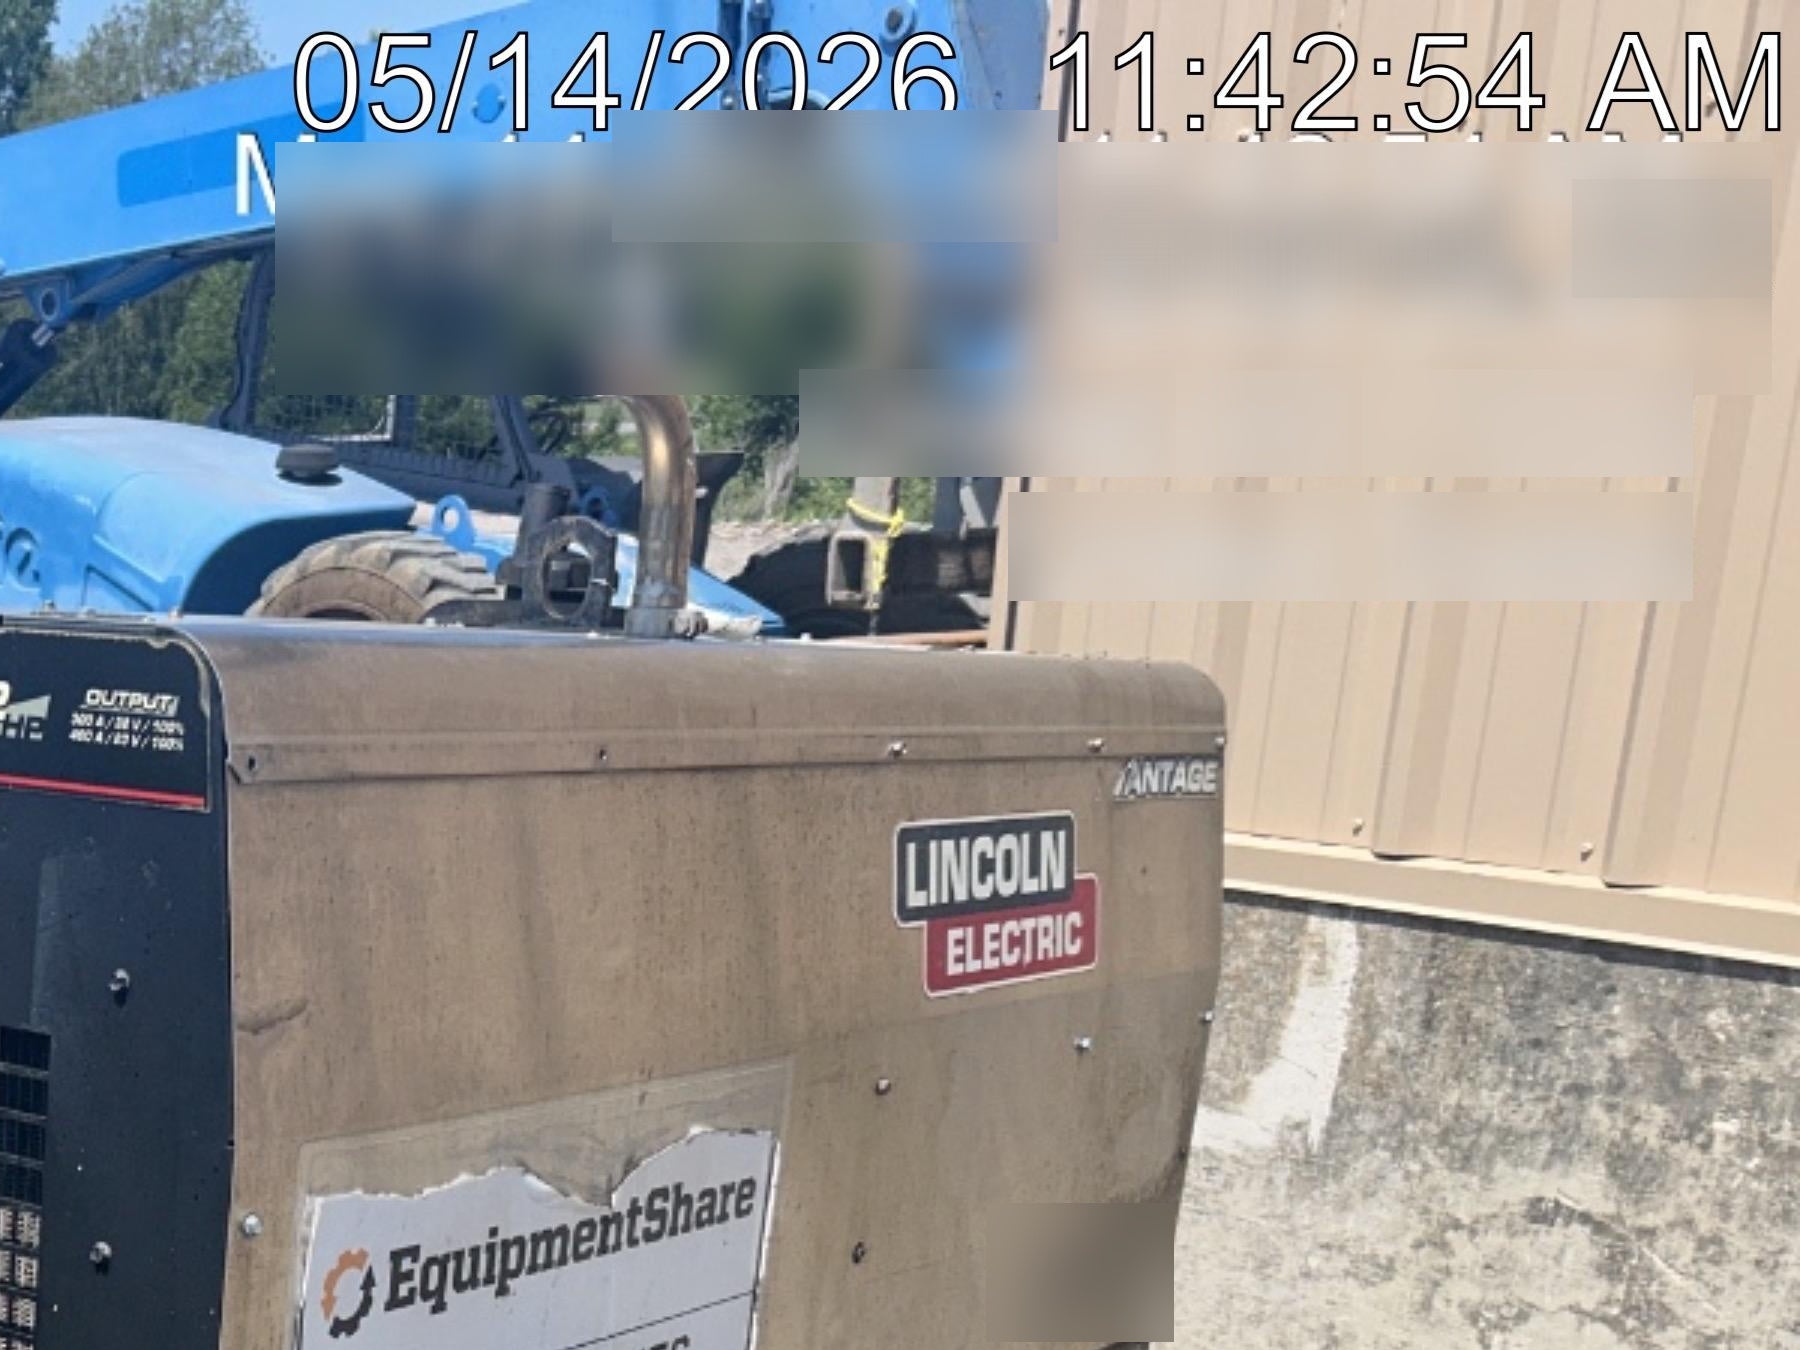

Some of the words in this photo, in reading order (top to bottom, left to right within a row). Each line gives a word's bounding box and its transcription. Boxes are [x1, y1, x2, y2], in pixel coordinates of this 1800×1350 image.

[85, 688, 174, 712] OUTPUT
[905, 829, 1067, 909] LINCOLN
[946, 911, 1083, 977] ELECTRIC
[383, 1176, 757, 1314] EquipmentShare
